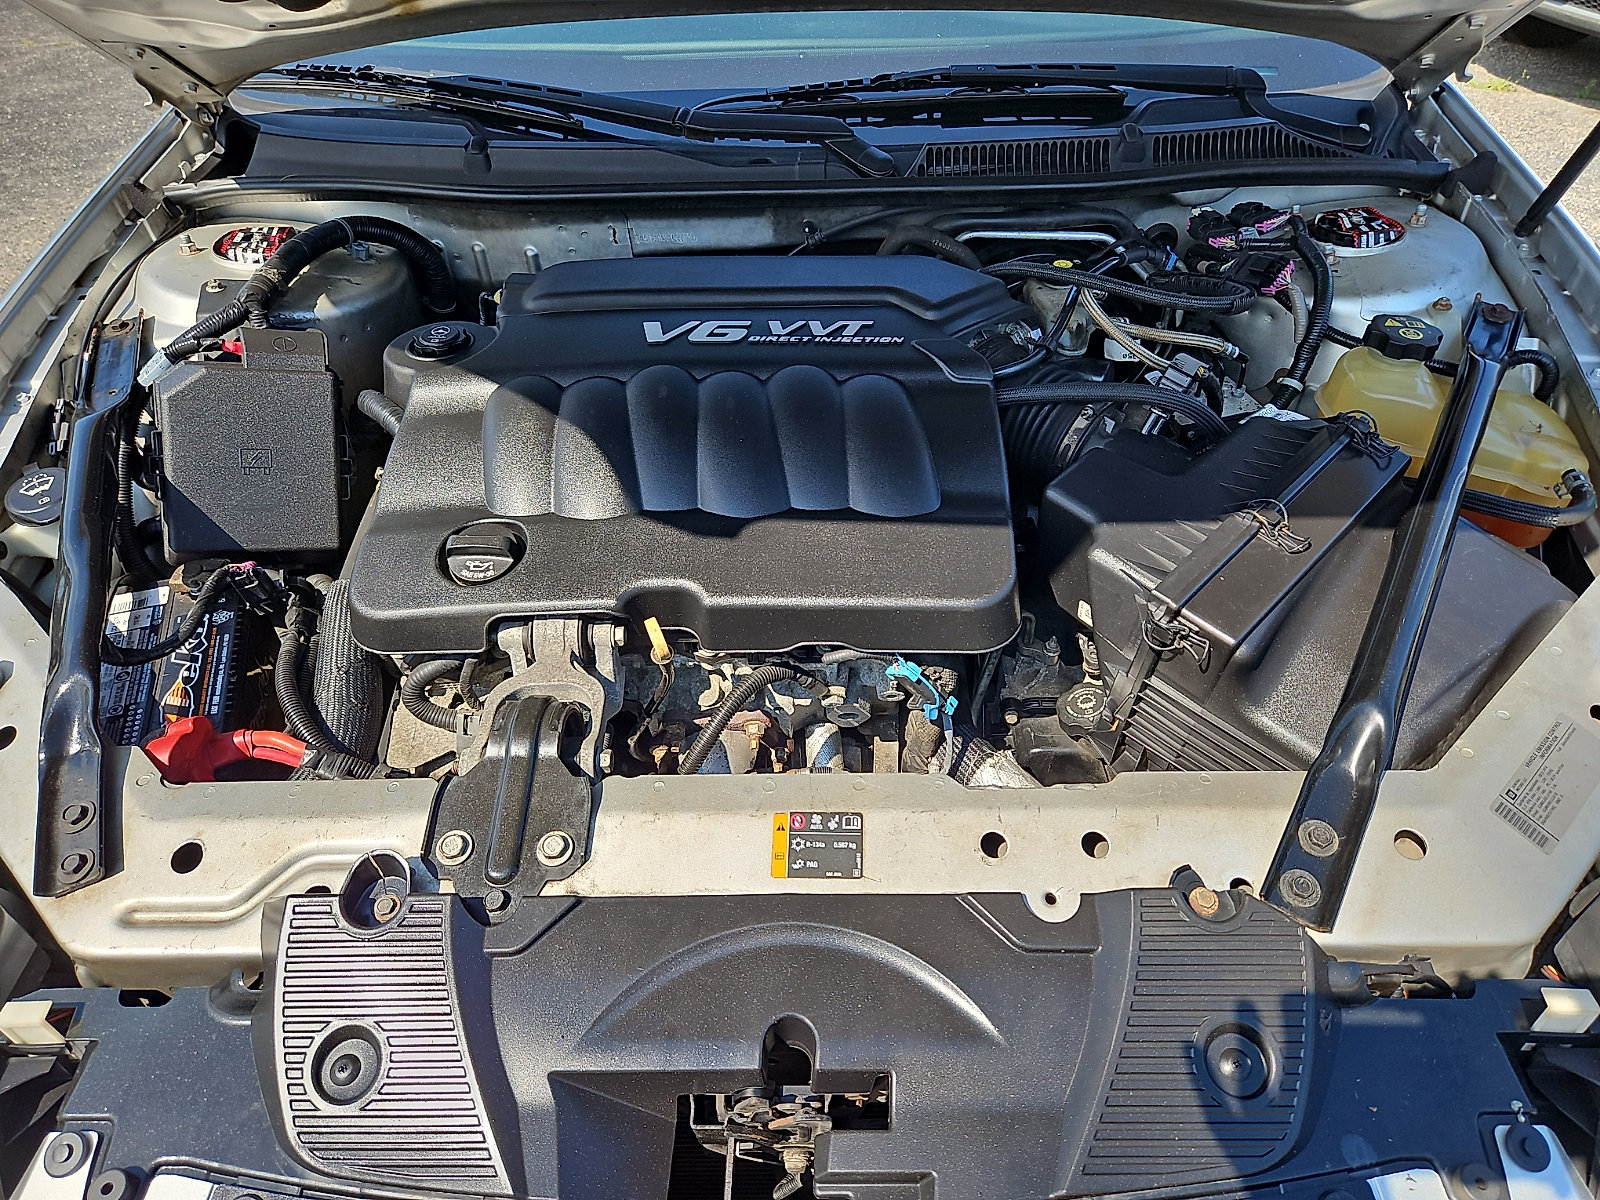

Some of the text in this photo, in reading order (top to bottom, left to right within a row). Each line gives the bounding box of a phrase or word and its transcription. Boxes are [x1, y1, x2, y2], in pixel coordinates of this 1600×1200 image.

[643, 320, 874, 343] V6 VVT
[748, 335, 904, 343] DIRECT INJECTION
